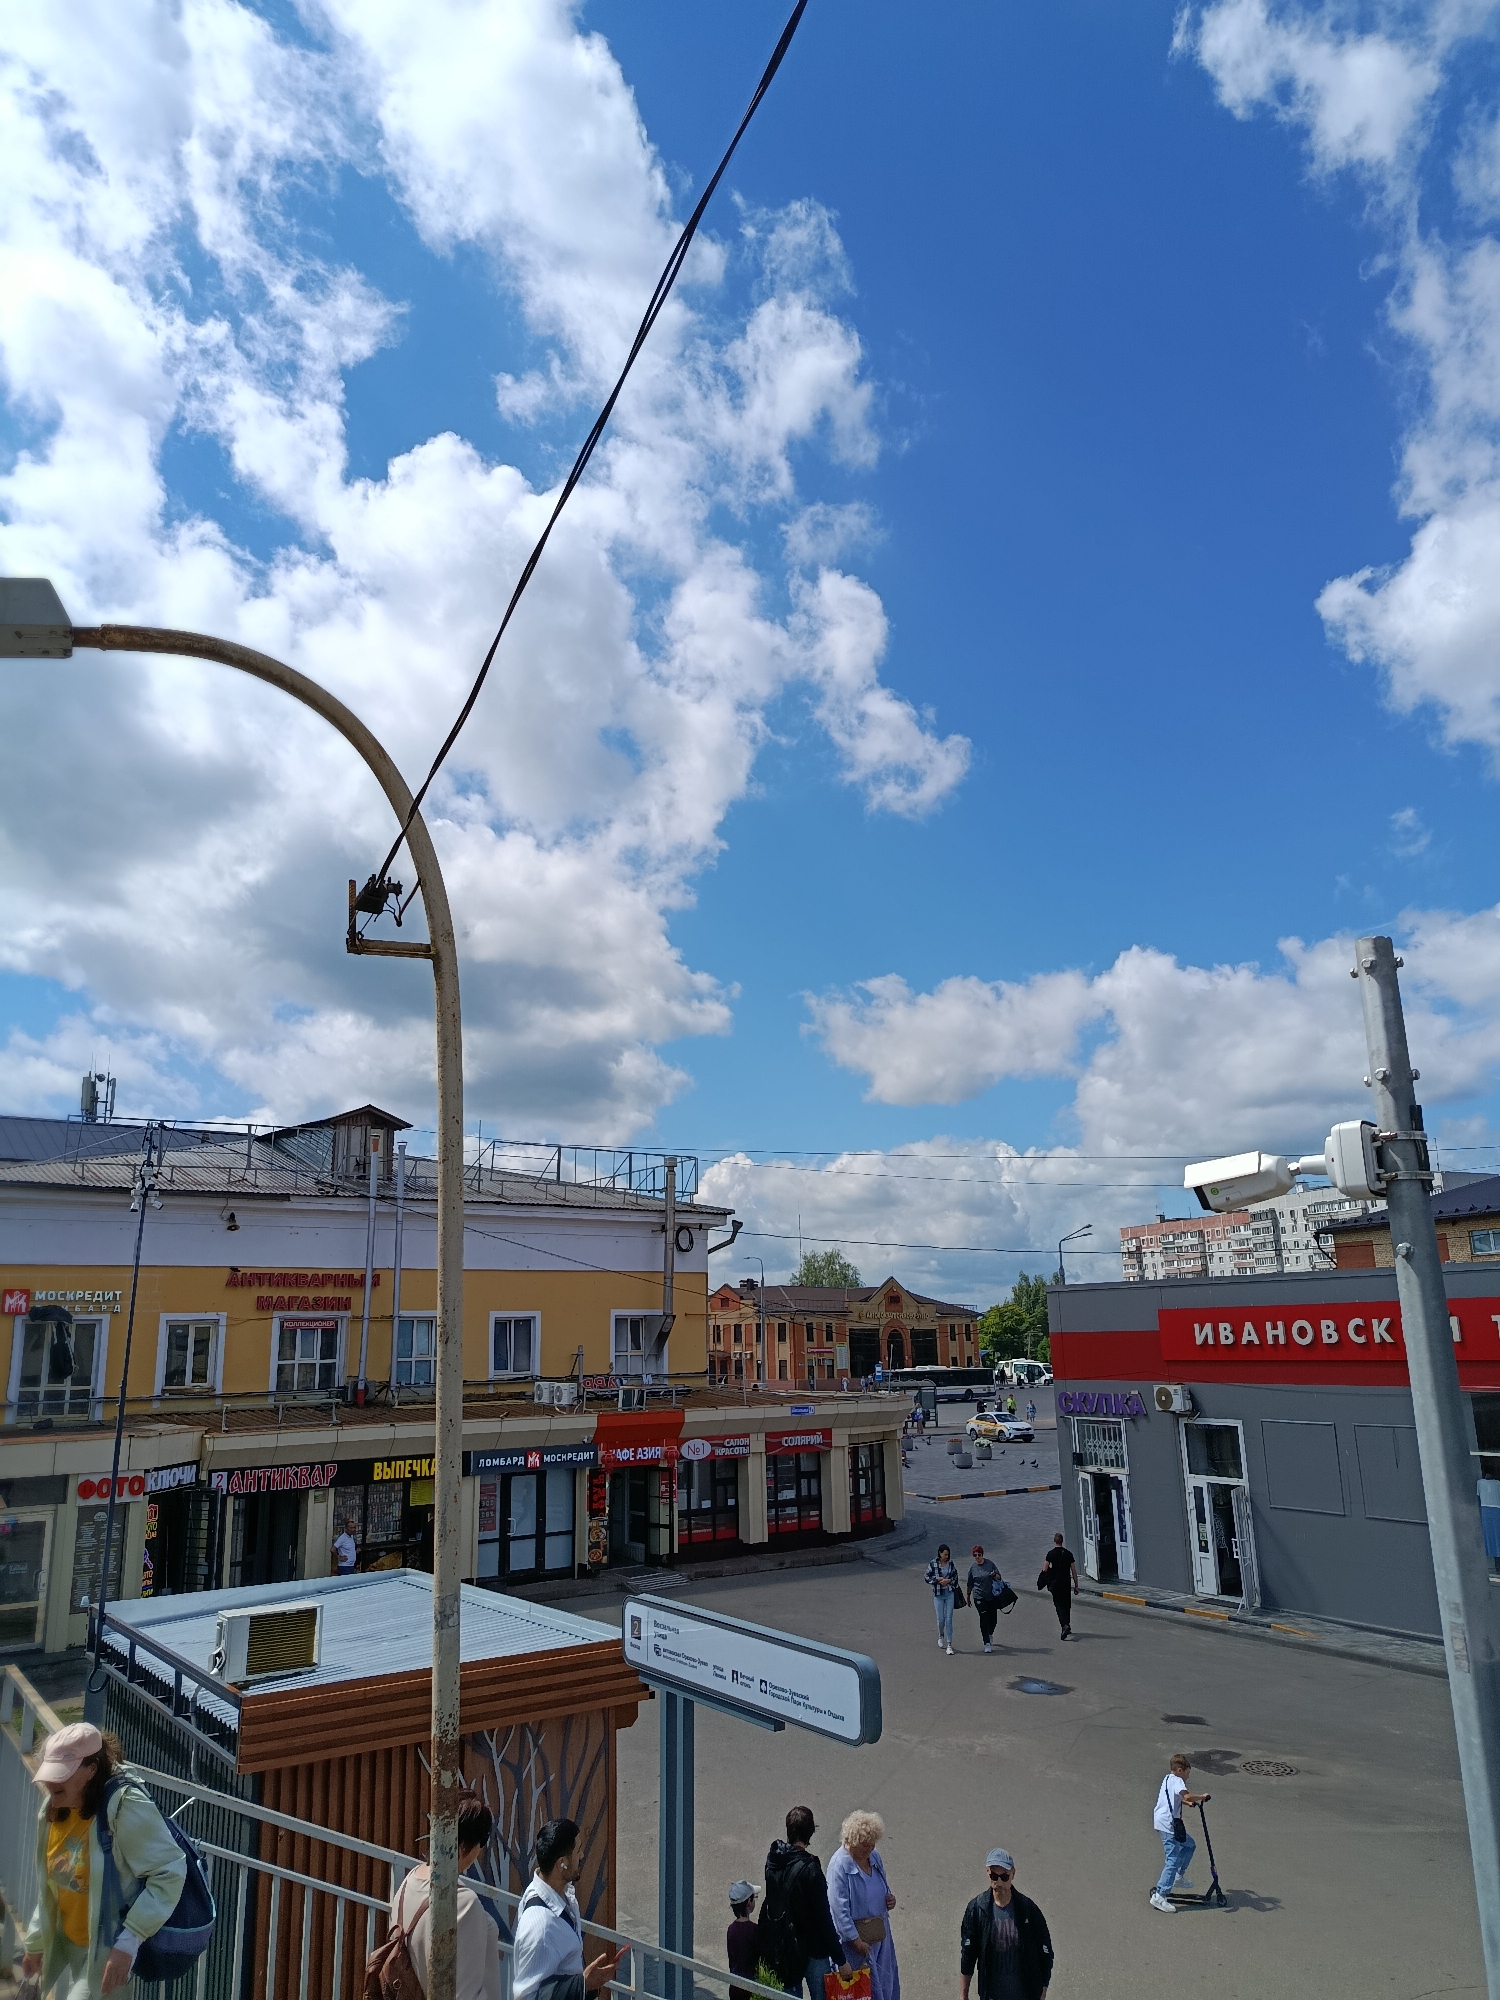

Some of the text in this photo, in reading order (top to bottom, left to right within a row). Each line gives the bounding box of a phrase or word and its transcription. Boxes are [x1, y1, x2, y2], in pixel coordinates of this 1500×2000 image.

[35, 1290, 122, 1303] МОСКРЕДИТ
[256, 1295, 352, 1310] МАГАЗИН
[35, 1304, 122, 1313] БАРД
[284, 1320, 335, 1328] КОЛЛЕКЦИОНЕР
[1193, 1316, 1462, 1346] ИВАНОВСК
[1058, 1391, 1148, 1416] СКУПКА
[723, 1438, 750, 1447] САЛОН
[782, 1431, 823, 1447] СОЛЯРИЙ
[478, 1456, 525, 1468] ЛОМБАРД
[543, 1451, 596, 1463] МОСКРЕДИТ
[609, 1446, 662, 1462] АФЕ АЗИЯ
[714, 1447, 750, 1456] КРАСОТЫ
[373, 1458, 436, 1481] ВЫПЕЧКА
[144, 1464, 197, 1493] КЛЮЧИ
[229, 1463, 338, 1494] АНТИКВАР
[77, 1475, 146, 1500] ФОТО
